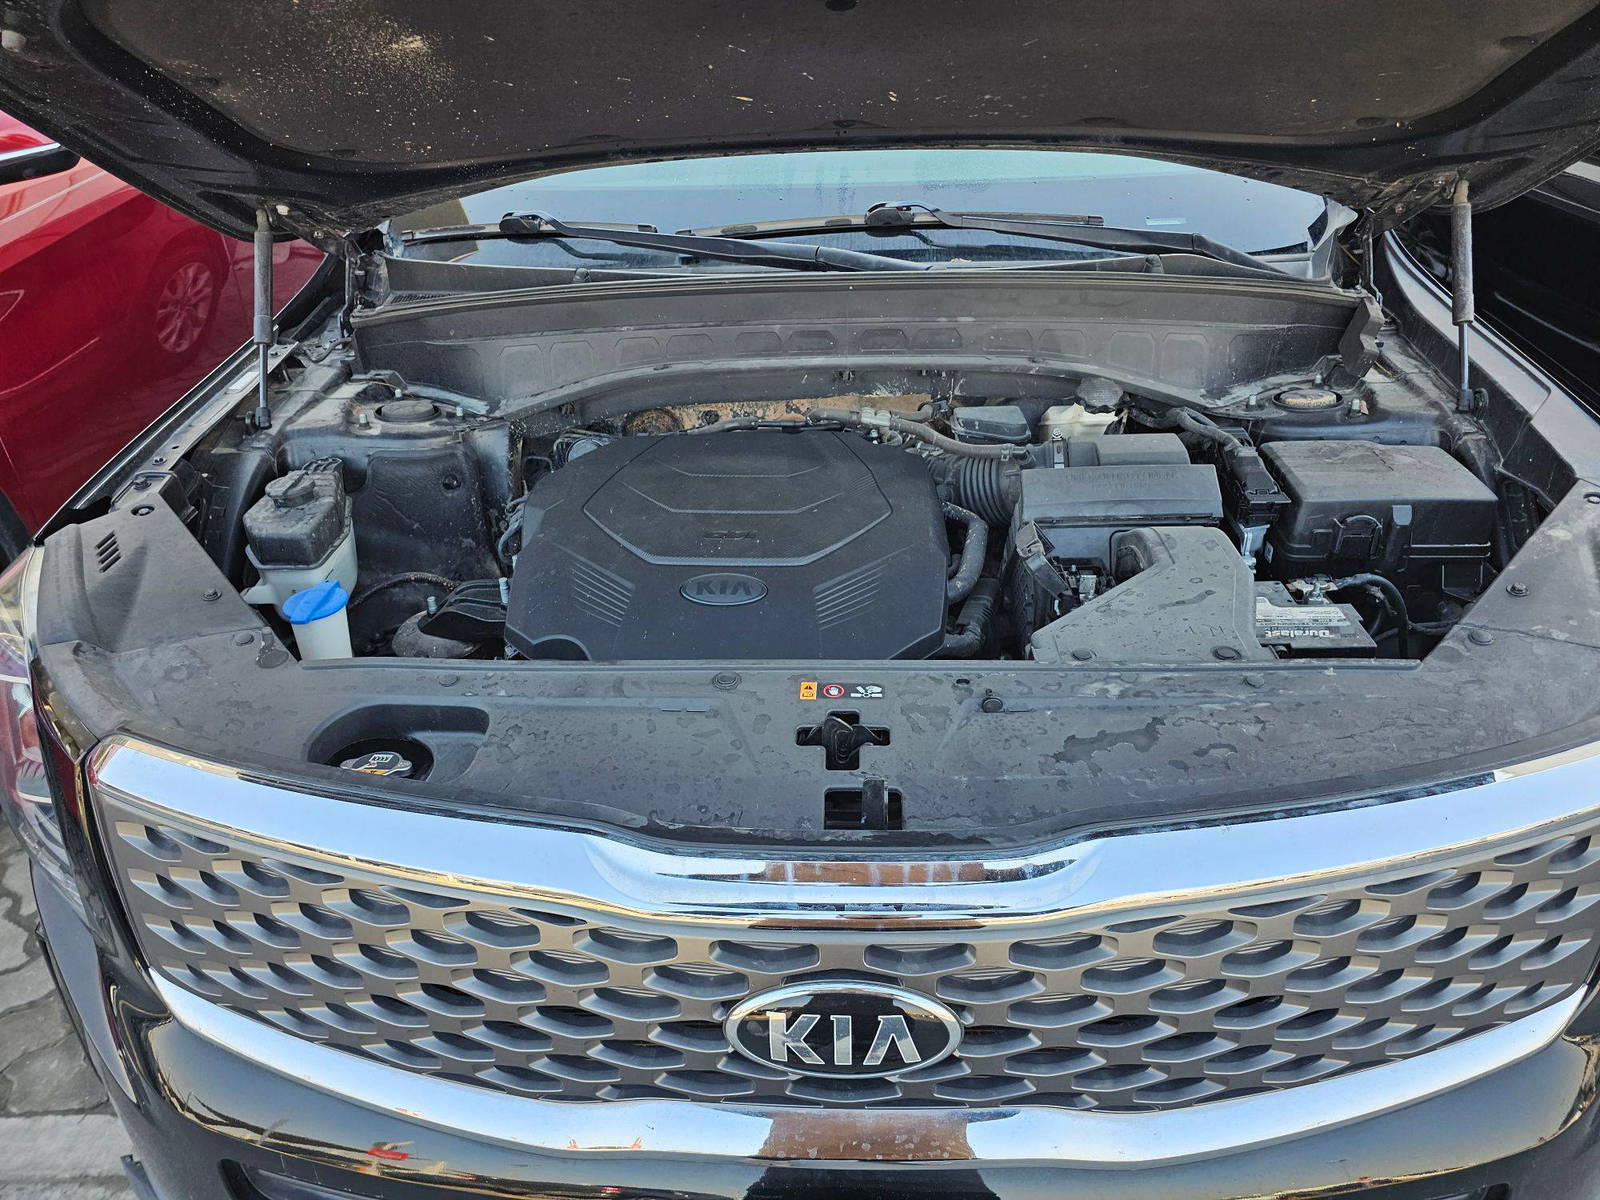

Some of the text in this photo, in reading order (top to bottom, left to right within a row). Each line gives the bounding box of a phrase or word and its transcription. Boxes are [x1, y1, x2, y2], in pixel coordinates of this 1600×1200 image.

[695, 580, 752, 596] KIA
[1264, 629, 1330, 638] Duralast
[766, 1011, 922, 1066] KIA
